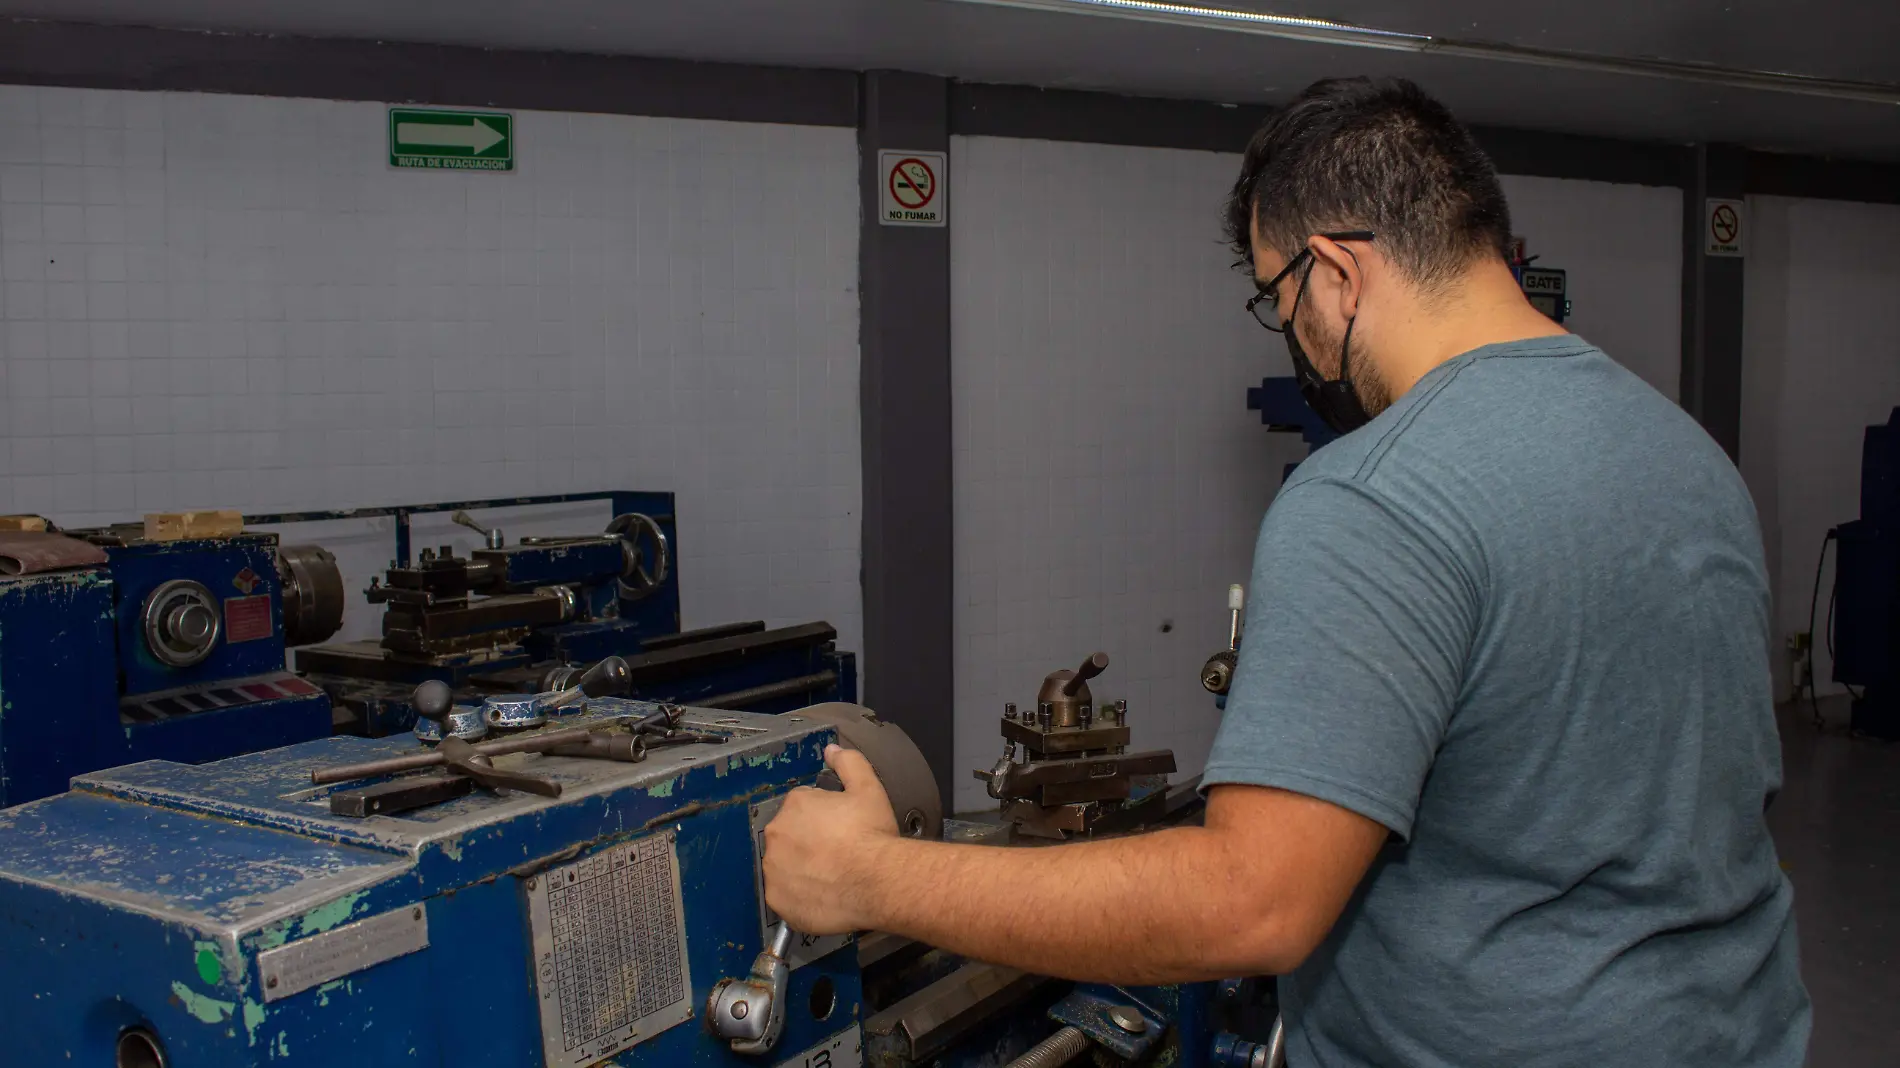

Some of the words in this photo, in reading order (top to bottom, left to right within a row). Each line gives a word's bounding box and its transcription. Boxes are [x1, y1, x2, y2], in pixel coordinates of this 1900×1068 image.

[398, 157, 424, 167] RUTA
[427, 158, 440, 168] DE
[890, 210, 902, 219] NO
[904, 211, 936, 220] FUMAR
[1526, 276, 1562, 290] GATE
